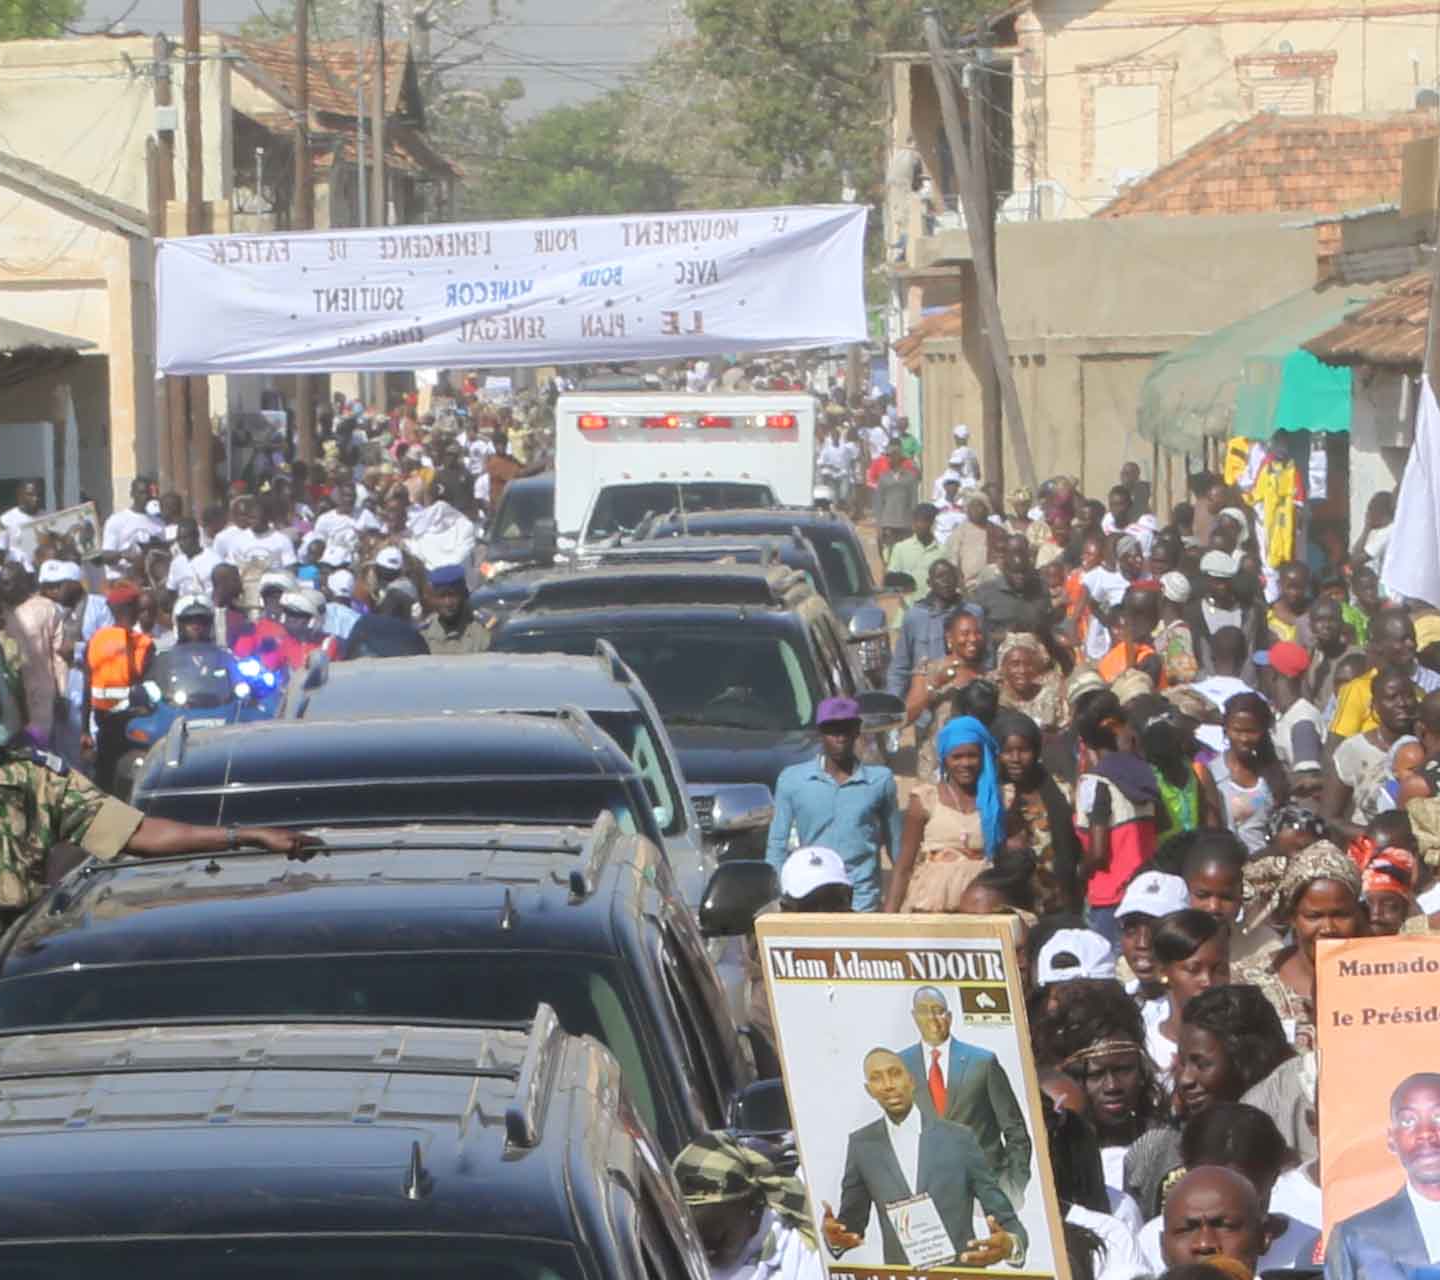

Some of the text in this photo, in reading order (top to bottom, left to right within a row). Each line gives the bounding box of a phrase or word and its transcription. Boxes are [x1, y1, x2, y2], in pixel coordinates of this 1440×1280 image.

[770, 948, 1005, 982] Mam Adama NDOUR
[1331, 1010, 1354, 1028] le
